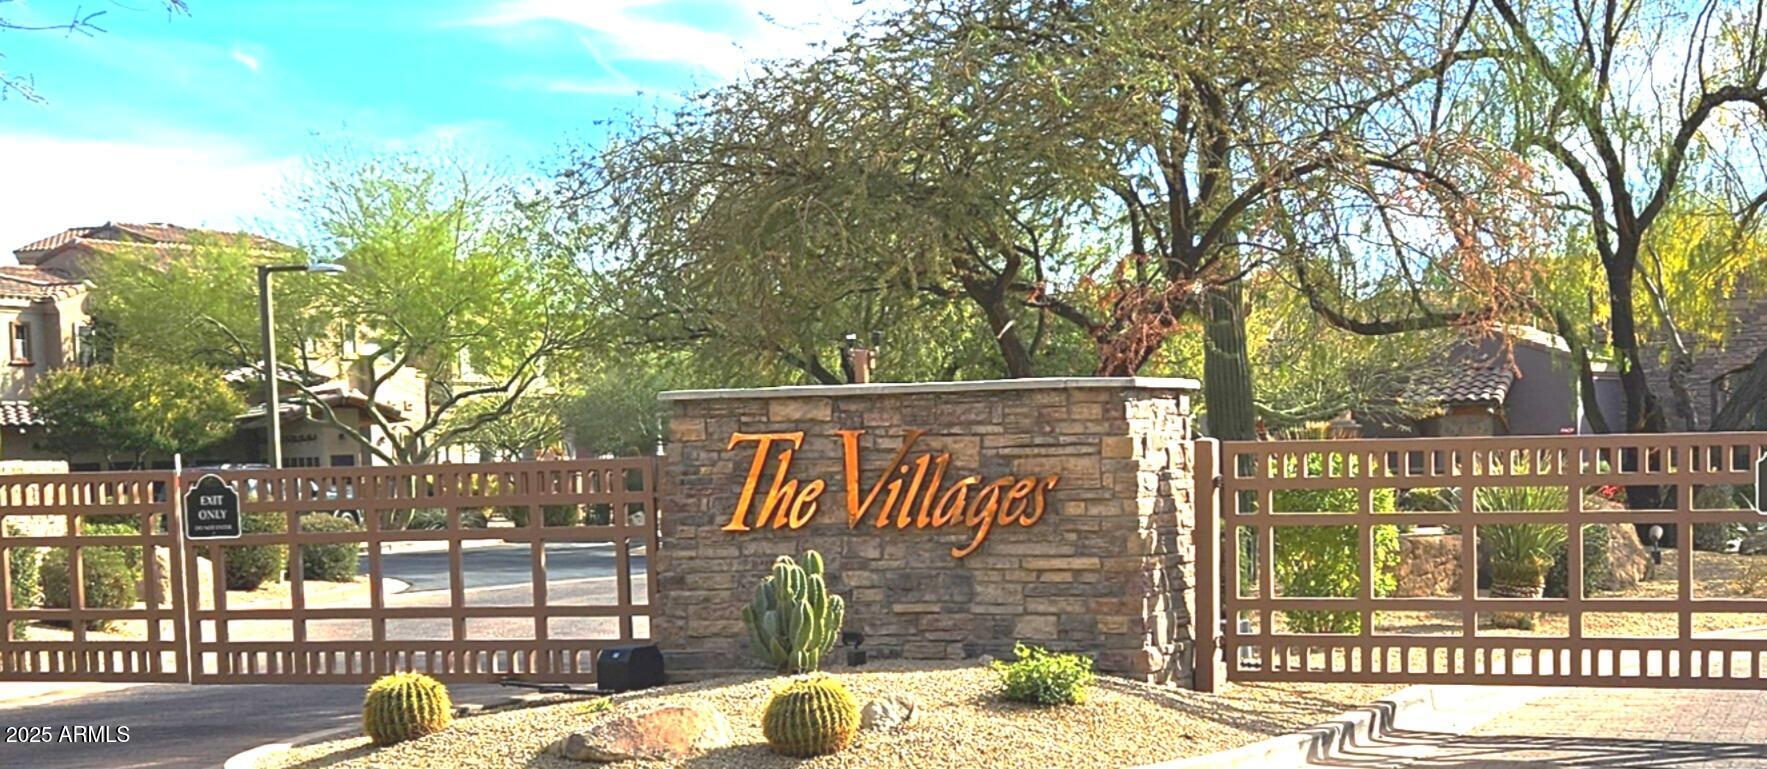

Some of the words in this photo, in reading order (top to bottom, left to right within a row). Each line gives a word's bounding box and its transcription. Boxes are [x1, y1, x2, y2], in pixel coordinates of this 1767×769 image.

[721, 430, 825, 532] The
[834, 429, 1062, 558] Villages
[200, 495, 224, 506] EXIT
[198, 509, 228, 520] ONLY
